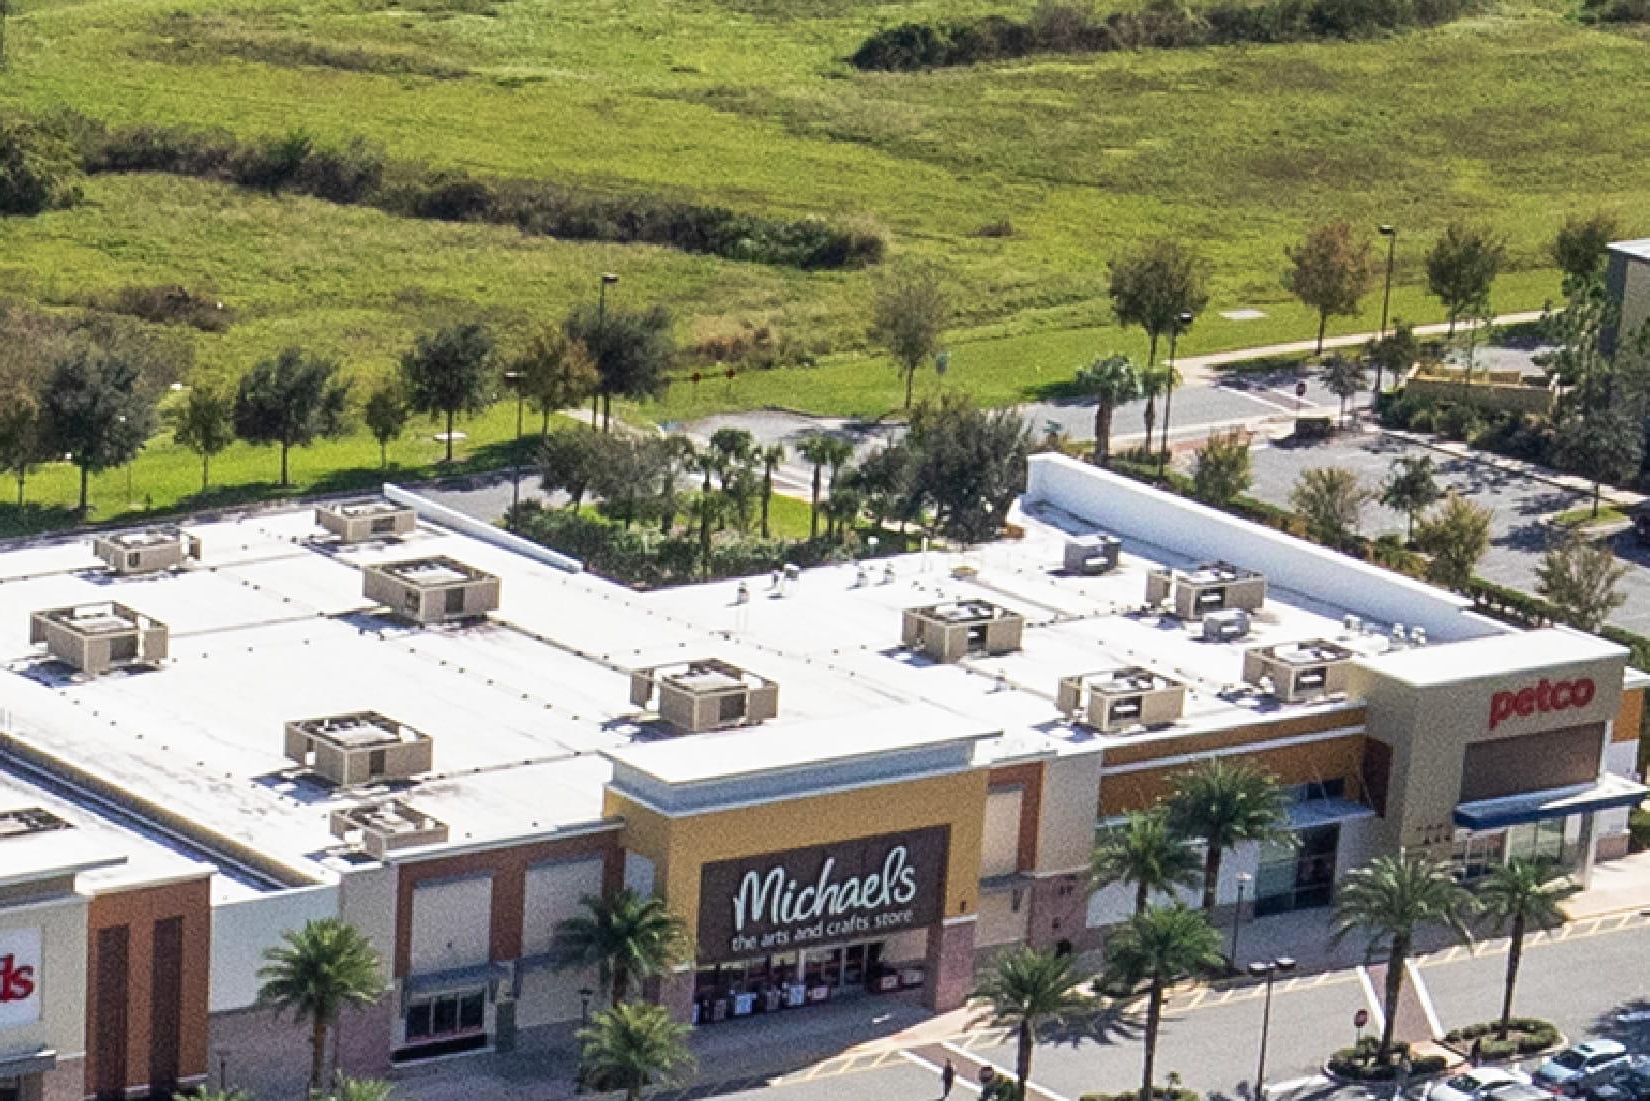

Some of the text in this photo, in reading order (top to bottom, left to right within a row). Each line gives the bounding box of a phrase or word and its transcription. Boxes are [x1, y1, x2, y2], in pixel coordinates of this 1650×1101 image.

[1490, 678, 1595, 729] petco
[733, 846, 916, 931] Michaels
[731, 909, 912, 952] the arts and crafts store
